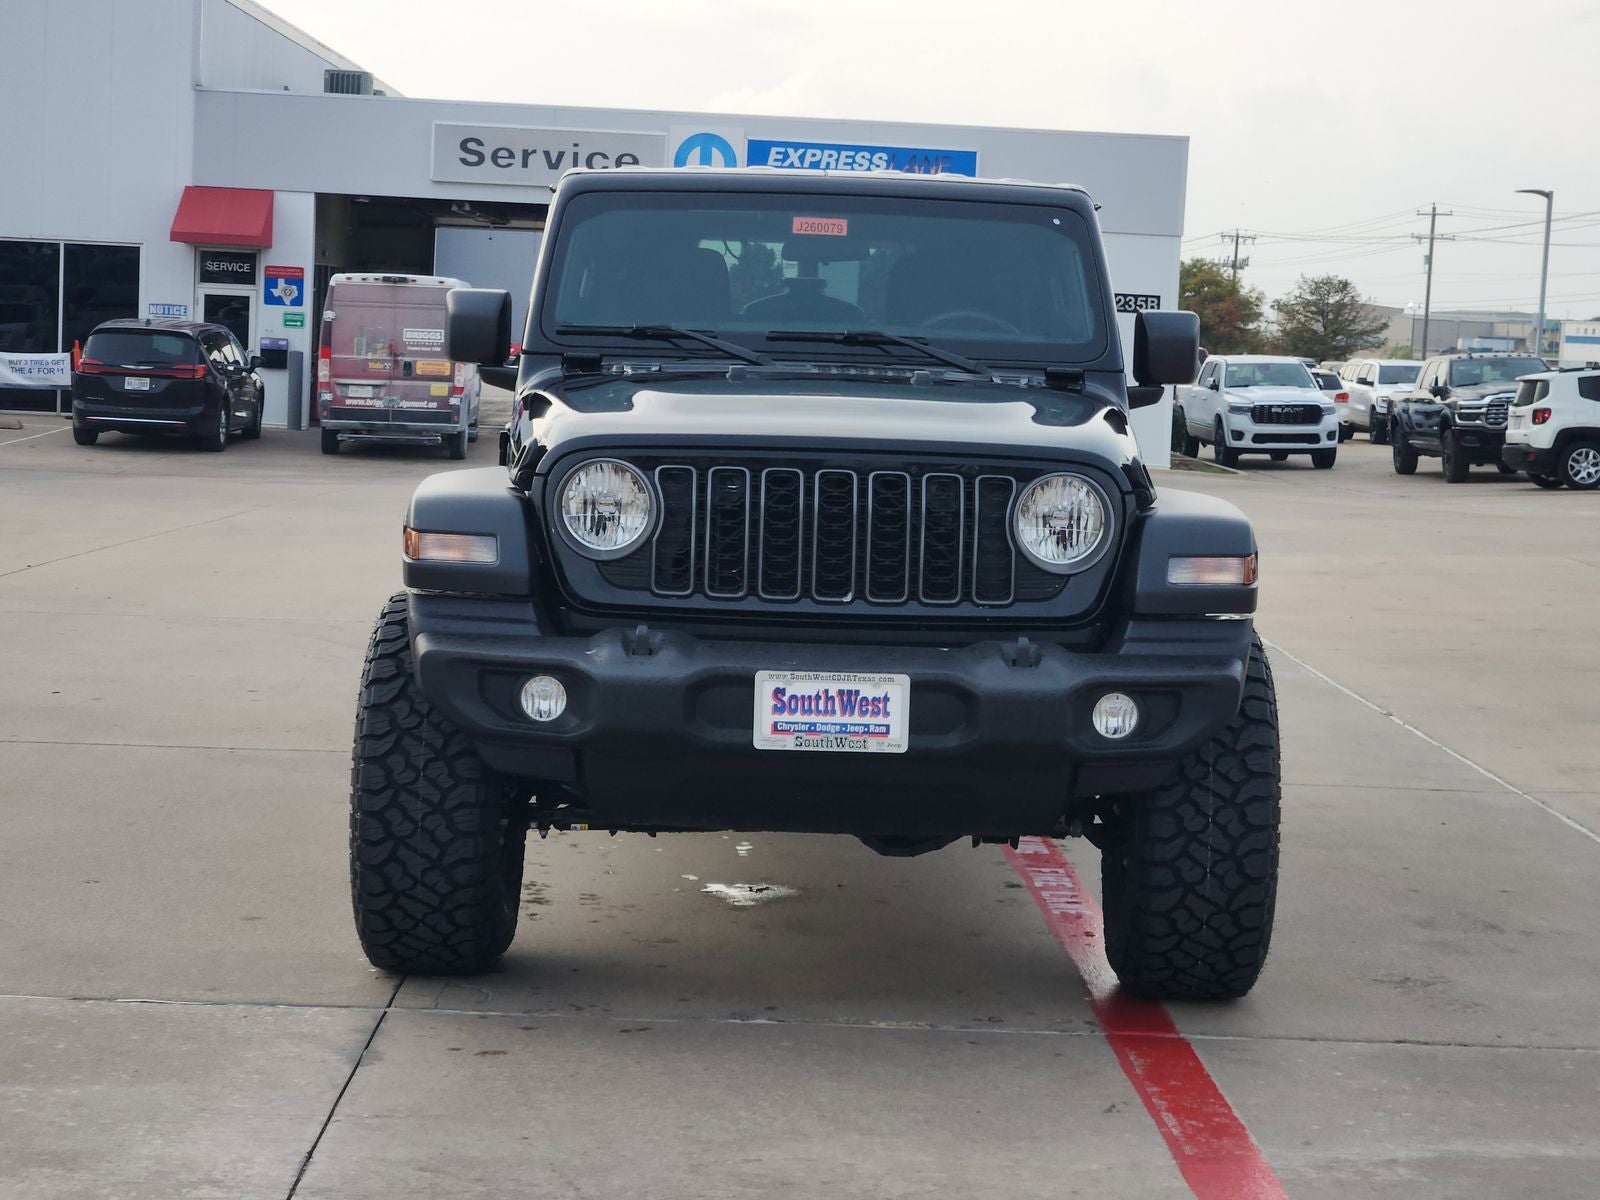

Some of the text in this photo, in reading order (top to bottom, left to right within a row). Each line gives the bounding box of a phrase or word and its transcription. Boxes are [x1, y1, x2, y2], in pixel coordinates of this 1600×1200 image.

[458, 137, 640, 170] Service
[767, 146, 888, 171] EXPRESS
[797, 221, 843, 233] J260079
[206, 261, 250, 272] SERVICE
[1115, 295, 1158, 311] 235B
[149, 304, 187, 315] NOTICE
[406, 331, 441, 340] BRIGGS
[10, 366, 26, 374] THE
[771, 686, 891, 718] SouthWest
[777, 722, 887, 734] Chrysler Dodge Jeep Ram
[794, 736, 868, 749] SouthWest
